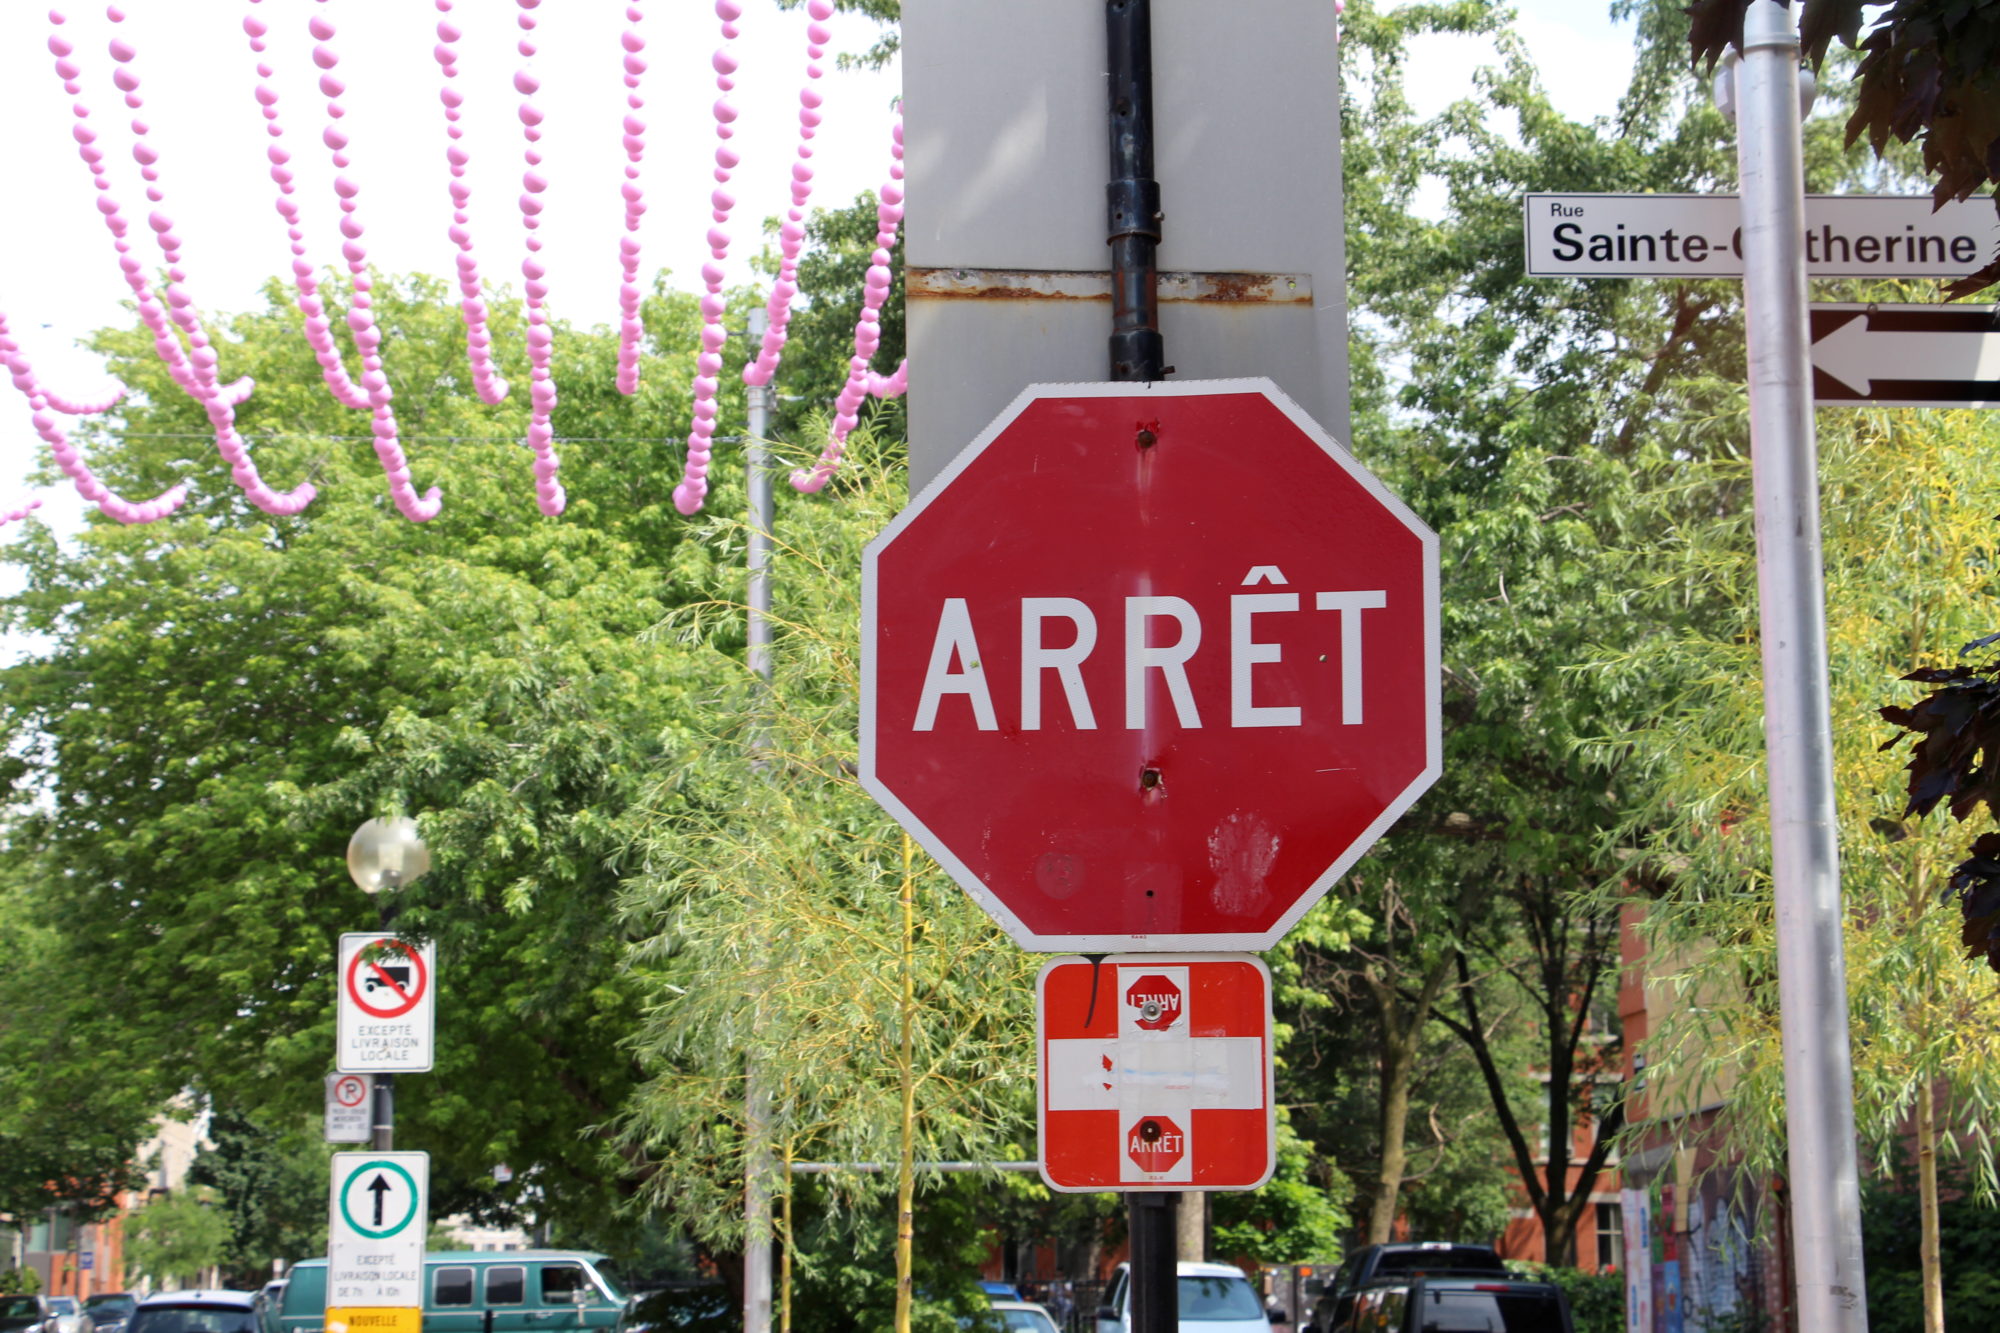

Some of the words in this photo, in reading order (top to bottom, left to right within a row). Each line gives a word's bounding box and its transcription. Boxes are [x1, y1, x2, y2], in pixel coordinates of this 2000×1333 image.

[1551, 203, 1584, 218] Rue
[1552, 223, 1977, 263] Sainte-therine
[912, 565, 1387, 731] ARRÊT
[351, 1037, 419, 1049] LIVRAISON
[360, 1050, 409, 1061] LOCALE
[1130, 1132, 1182, 1153] ARRÊT
[334, 1271, 381, 1281] LIVRAISON
[382, 1271, 417, 1281] LOCALE
[337, 1287, 349, 1297] DE
[348, 1315, 398, 1327] NOUVELLE
